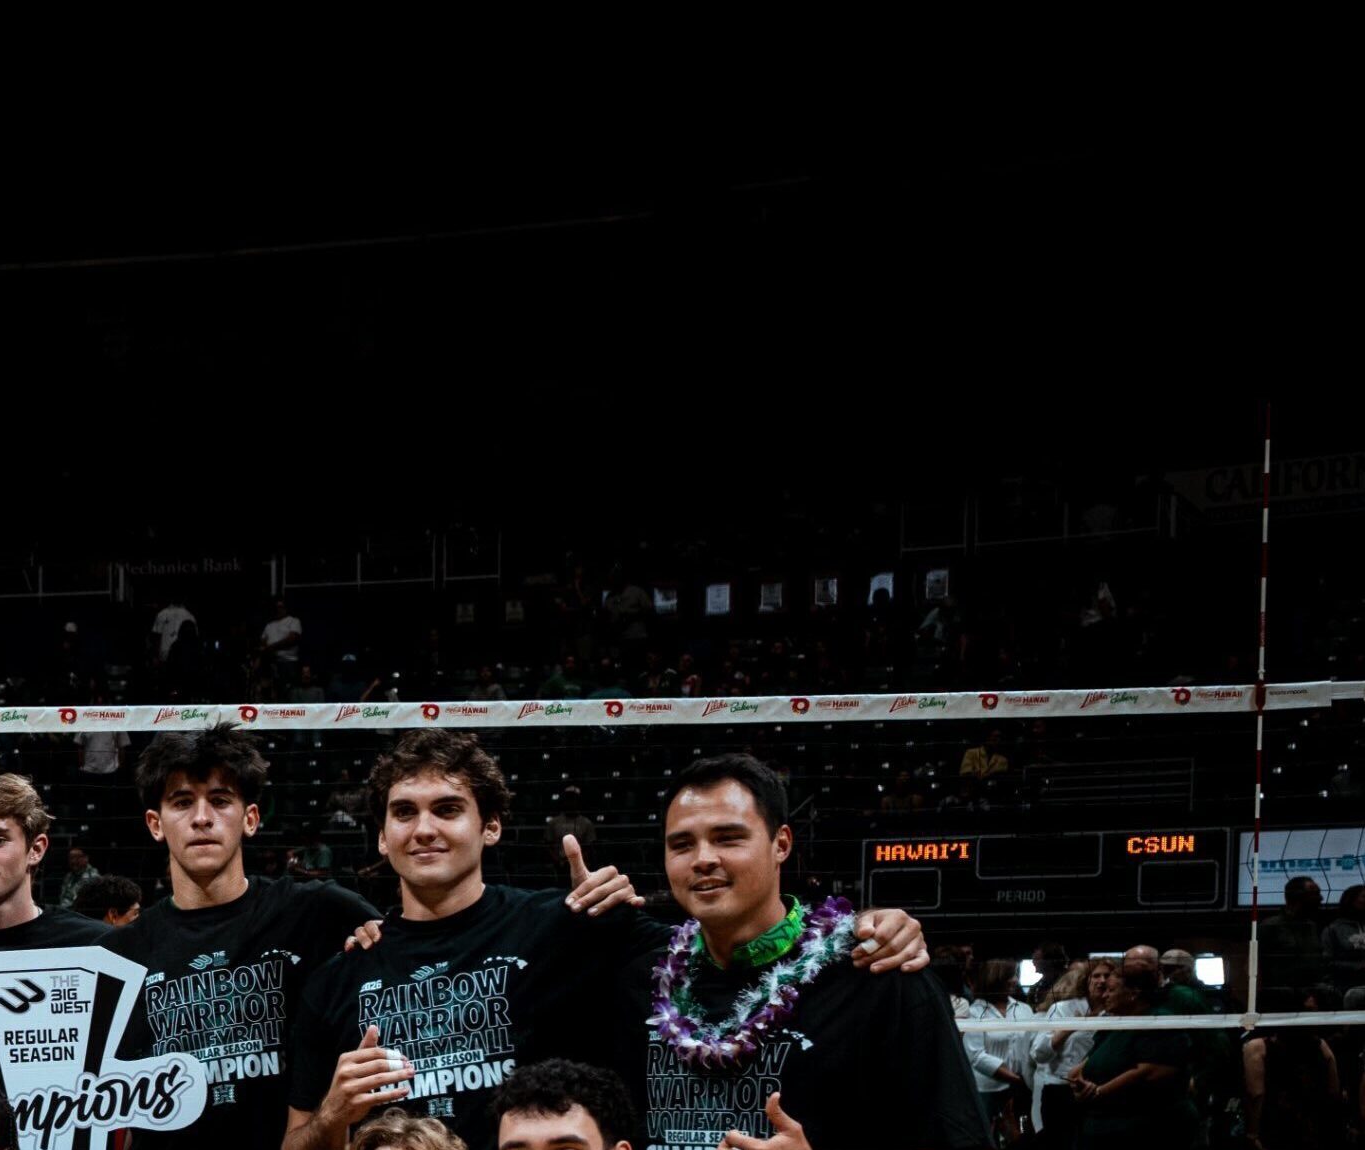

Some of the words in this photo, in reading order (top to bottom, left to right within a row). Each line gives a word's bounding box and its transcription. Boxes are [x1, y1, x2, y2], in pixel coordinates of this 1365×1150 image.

[1127, 835, 1196, 855] CSUN
[996, 890, 1047, 904] PERIOD
[50, 975, 79, 988] THE
[146, 960, 283, 1014] RAINBOW
[51, 988, 78, 1002] BIG
[358, 966, 508, 1023] RAINBOW
[50, 1000, 91, 1014] WEST
[148, 992, 286, 1042] WARRIOR
[4, 1027, 79, 1045] REGULAR
[10, 1045, 75, 1063] SEASON
[223, 1041, 260, 1055] SEASON
[449, 1052, 481, 1066] SEASON
[647, 1077, 781, 1112] WARRIOR
[13, 1064, 187, 1150] mpions
[668, 1131, 706, 1143] REGULAR
